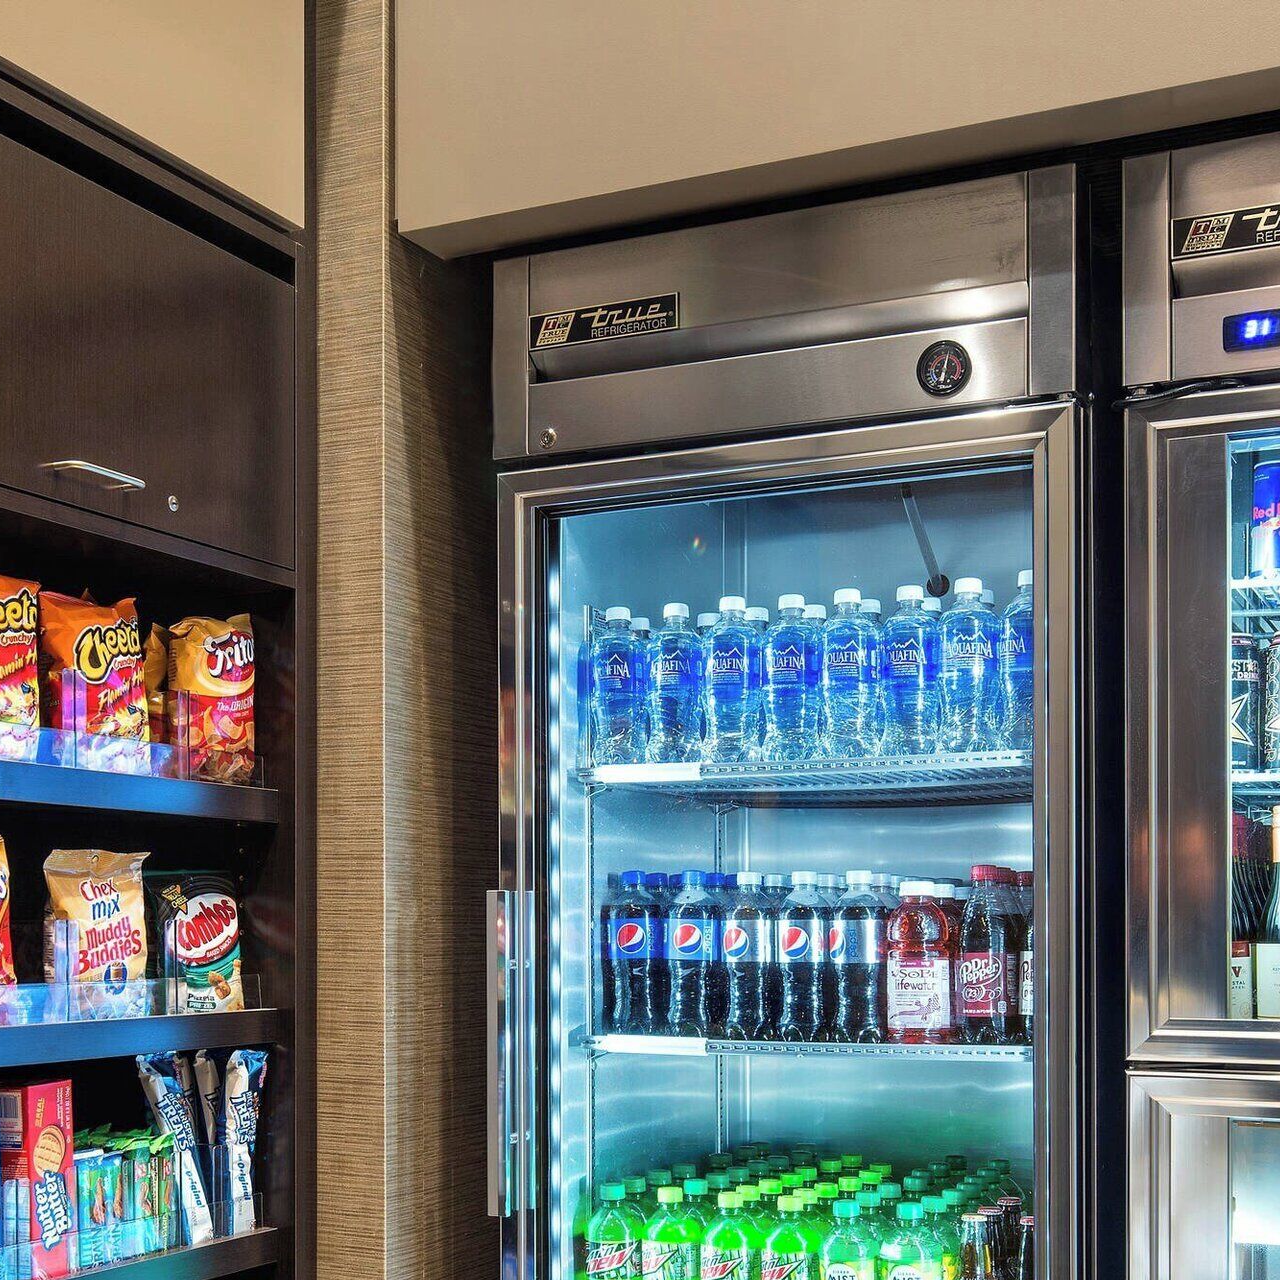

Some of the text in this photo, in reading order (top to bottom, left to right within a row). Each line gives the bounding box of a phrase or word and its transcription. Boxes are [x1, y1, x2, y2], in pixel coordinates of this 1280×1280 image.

[580, 304, 667, 327] true
[591, 318, 667, 338] REFRIGERATOR
[1253, 502, 1275, 520] Red
[0, 632, 33, 646] Crunchy
[204, 632, 254, 677] Frito
[79, 878, 117, 902] Chex
[86, 916, 132, 951] Muddy
[178, 898, 237, 951] Combos
[74, 929, 142, 977] Buddies
[961, 964, 1000, 982] Pepper
[155, 1096, 190, 1152] TREATS
[229, 1092, 250, 1145] TREATS
[237, 1161, 252, 1201] Original
[36, 1181, 60, 1250] Nutter
[44, 1170, 71, 1237] Butter
